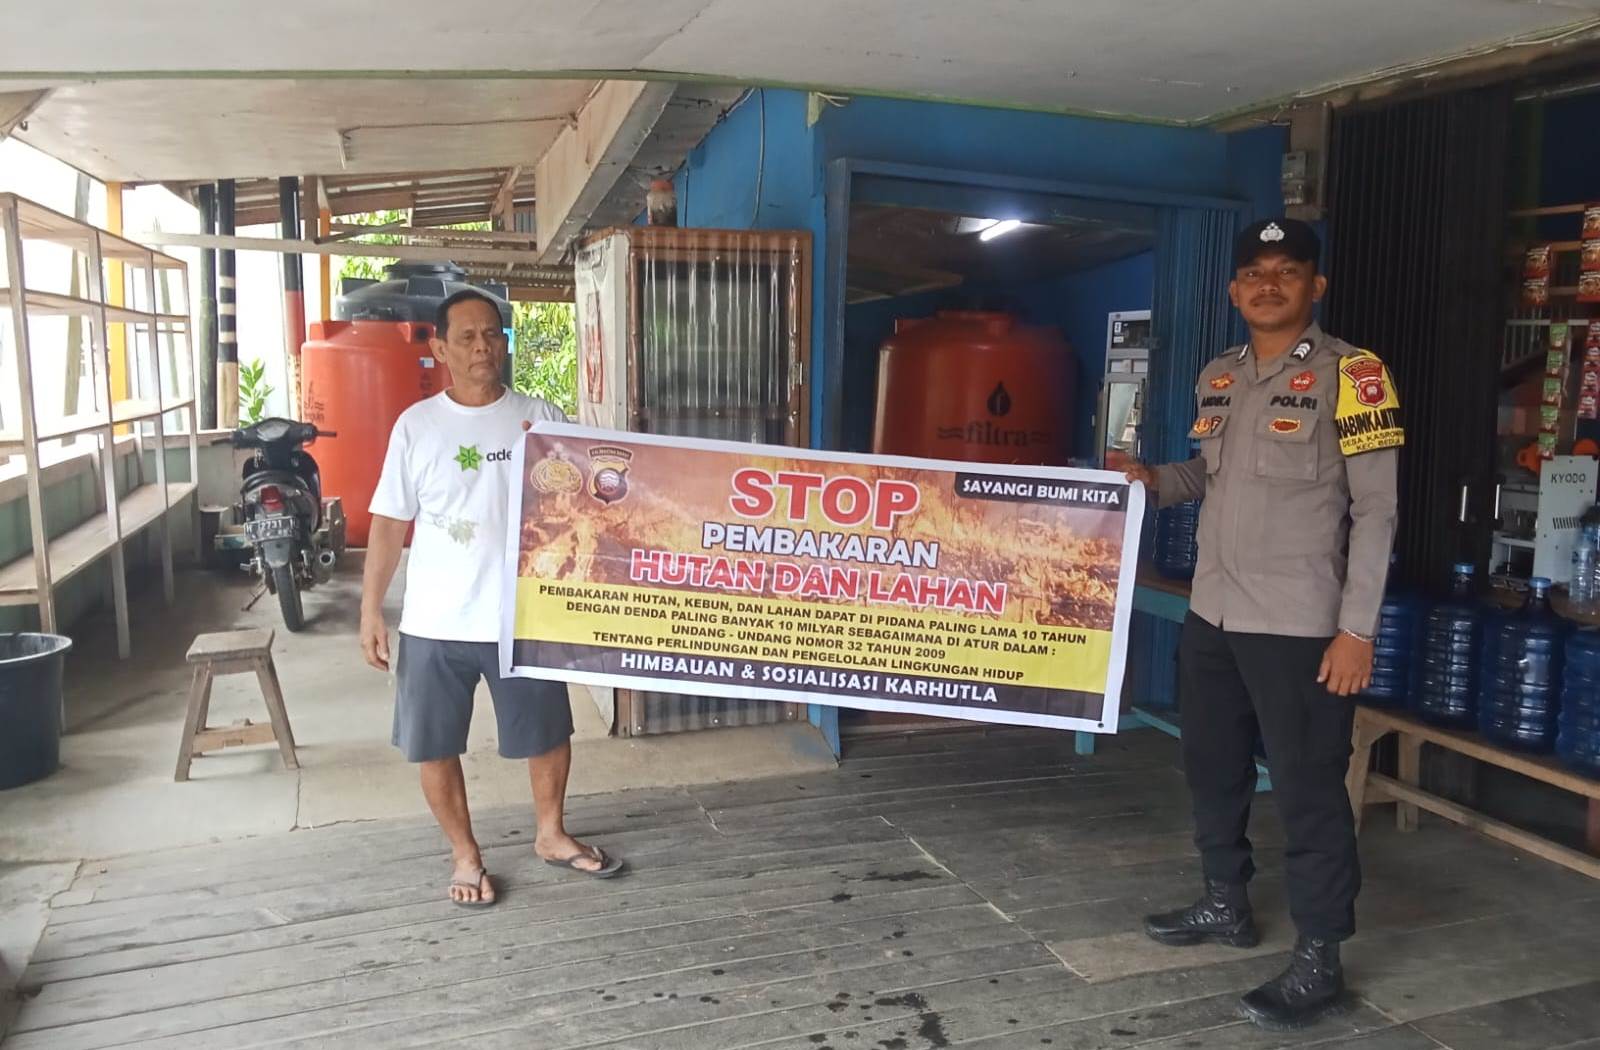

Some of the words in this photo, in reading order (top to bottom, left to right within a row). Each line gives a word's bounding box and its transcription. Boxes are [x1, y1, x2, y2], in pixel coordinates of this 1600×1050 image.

[1270, 395, 1318, 410] POLRI
[967, 419, 1027, 446] filtra
[729, 467, 920, 531] STOP
[963, 479, 1033, 497] SAYANGI
[1036, 486, 1078, 501] BUMI
[1082, 489, 1119, 504] KITA
[1551, 473, 1586, 484] KYODO
[702, 521, 939, 569] PEMBAKARAN
[630, 549, 766, 591] HUTAN
[772, 561, 860, 600] DAN
[868, 570, 1007, 614] LAHAN
[539, 585, 629, 602] PEMBAKARAN
[633, 593, 680, 608] HUTAN,
[684, 598, 733, 613] KEBUN,
[737, 603, 763, 614] DAN
[767, 605, 811, 619] LAHAN
[815, 609, 857, 622] DAPAT
[860, 614, 873, 624] DI
[876, 615, 925, 629] PIDANA
[928, 620, 977, 634] PALING
[980, 625, 1017, 639] LAMA
[1022, 629, 1037, 640] 10
[1041, 631, 1087, 644] TAHUN
[566, 601, 620, 615] DENGAN
[624, 606, 667, 620] DENDA
[671, 610, 717, 624] PALING
[721, 615, 774, 629] BANYAK
[778, 620, 793, 631] 10
[797, 622, 844, 636] MILYAR
[847, 626, 943, 645] SEBAGAIMANA
[946, 636, 960, 647] DI
[963, 638, 999, 651] ATUR
[1003, 642, 1048, 655] DALAM
[593, 631, 653, 646] TENTANG
[656, 637, 758, 655] PERLINDUNGAN
[762, 647, 788, 659] DAN
[792, 650, 887, 668] PENGELOLAAN
[891, 659, 978, 676] LINGKUNGAN
[982, 668, 1024, 681] HIDUP
[671, 625, 726, 639] UNDANG
[737, 631, 791, 645] UNDANG
[796, 636, 843, 650] NOMOR
[847, 640, 863, 651] 32
[866, 642, 911, 656] TAHUN
[915, 647, 946, 659] 2009
[621, 652, 734, 678] HIMBAUAN
[741, 664, 756, 680] &
[762, 665, 879, 692] SOSIALISASI
[885, 677, 998, 703] KARHUTLA
